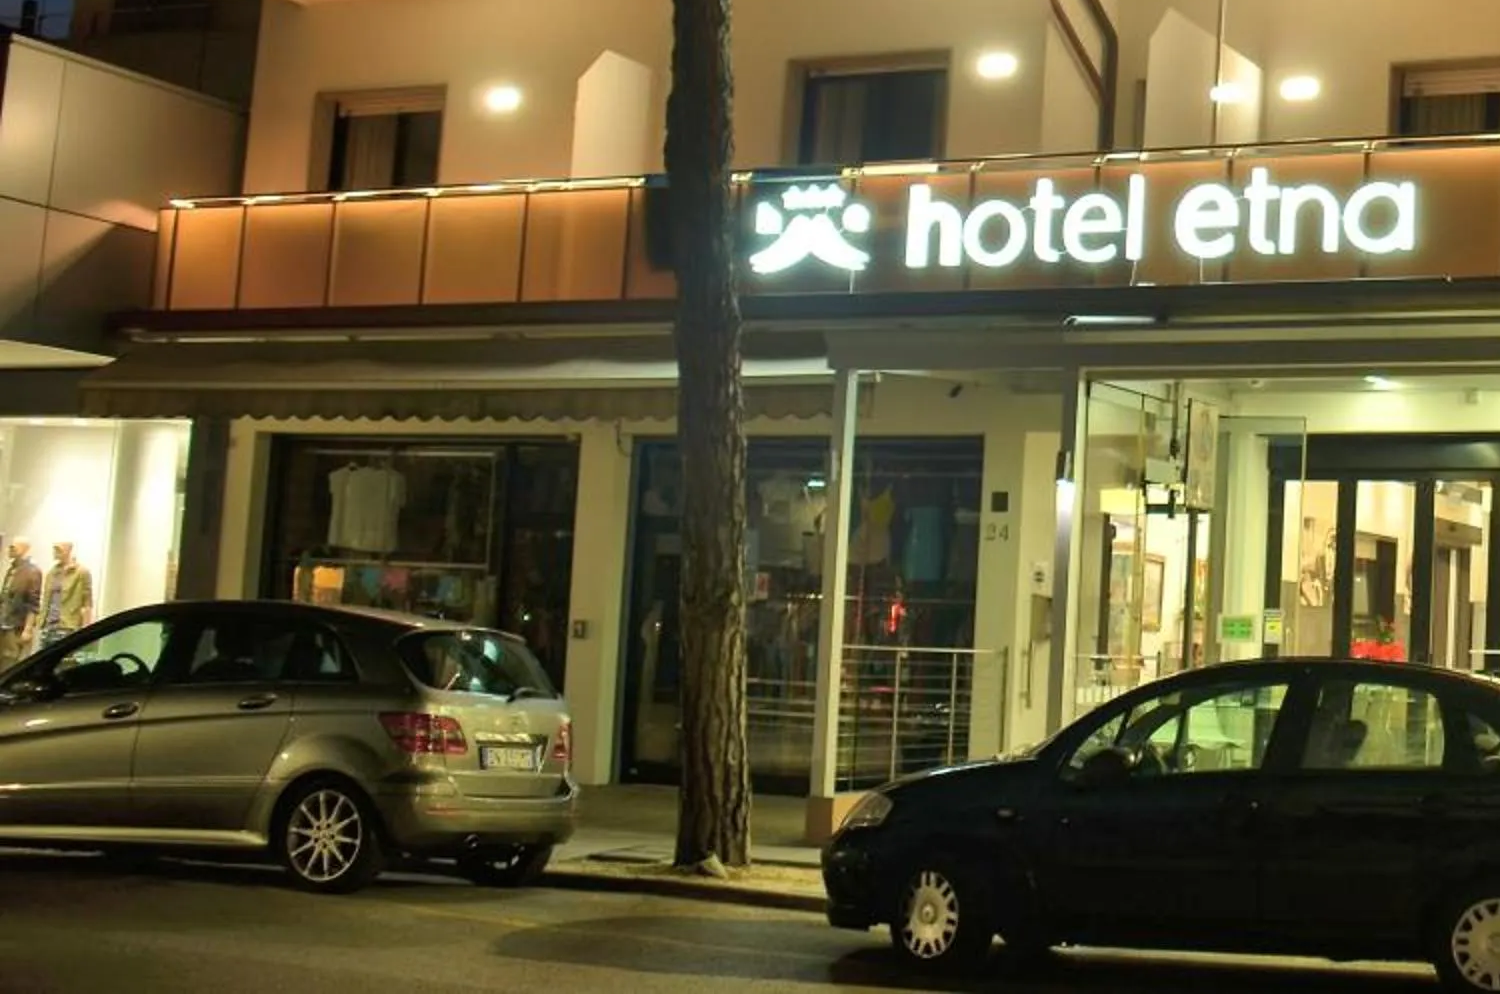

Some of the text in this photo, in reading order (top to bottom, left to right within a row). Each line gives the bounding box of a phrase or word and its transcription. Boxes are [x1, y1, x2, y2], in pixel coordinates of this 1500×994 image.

[904, 167, 1415, 268] hotel etna
[984, 522, 1010, 542] 24
